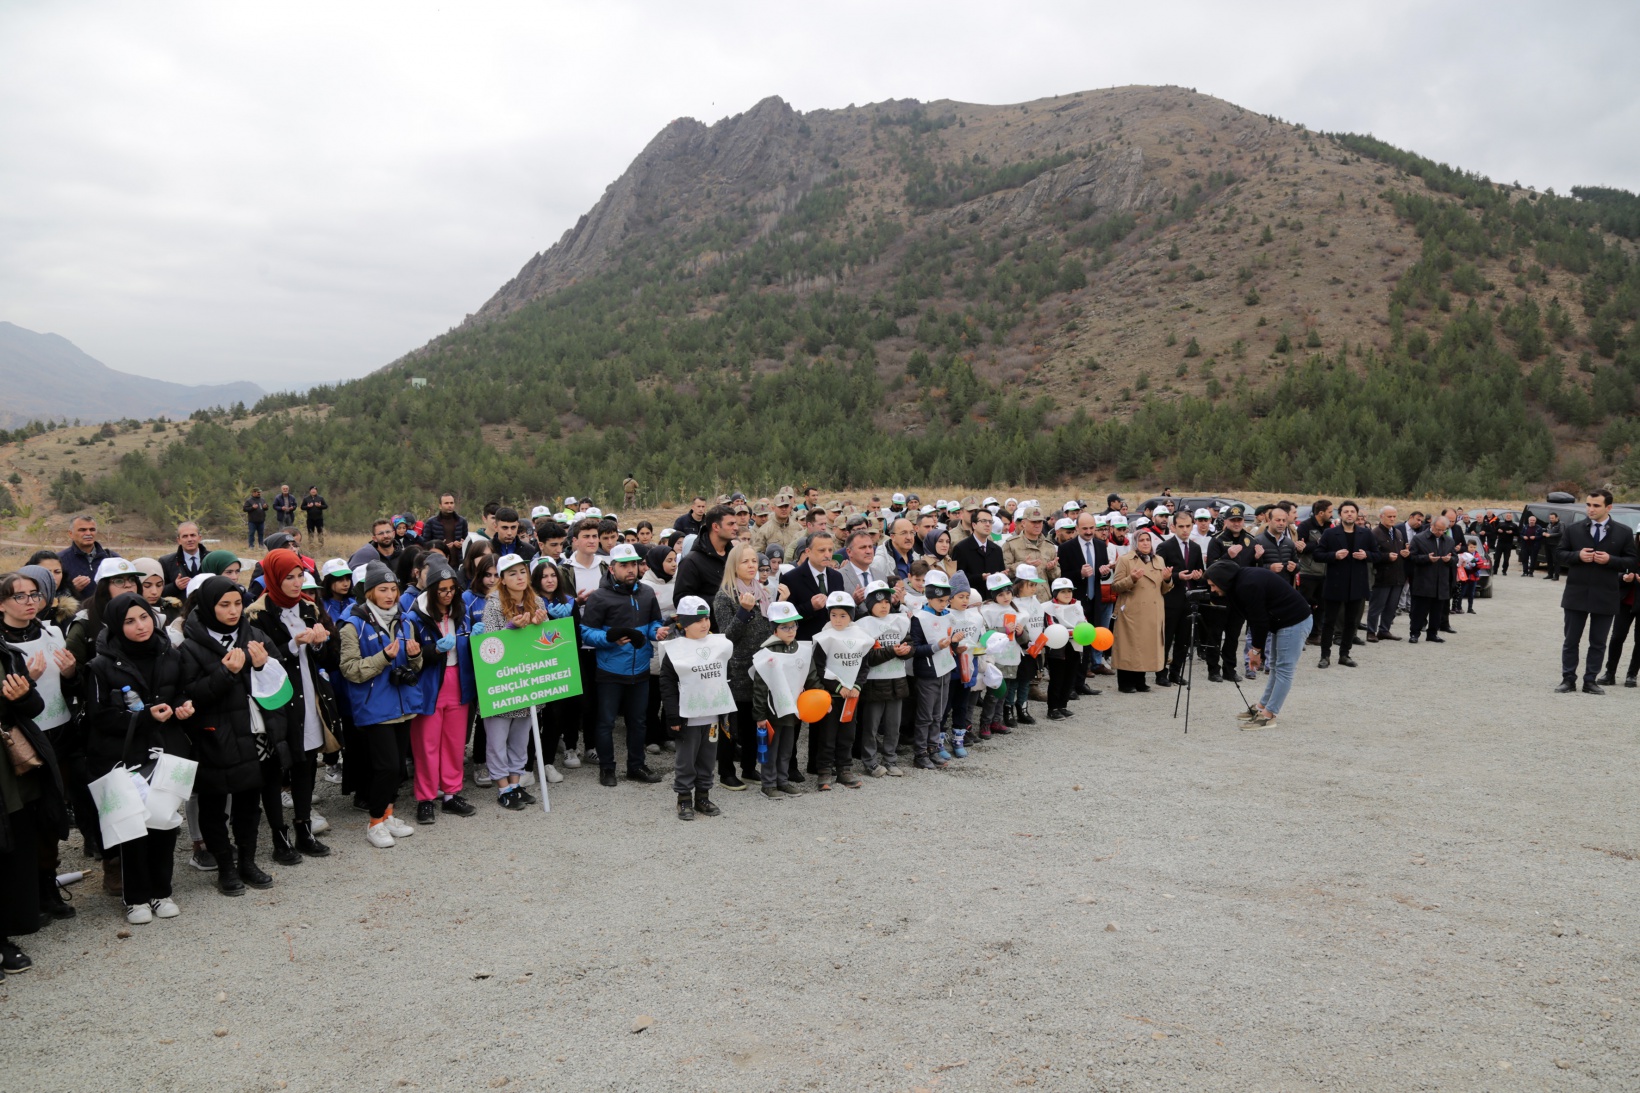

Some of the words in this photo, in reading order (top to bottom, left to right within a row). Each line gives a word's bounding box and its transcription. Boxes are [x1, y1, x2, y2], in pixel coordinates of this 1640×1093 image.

[496, 658, 558, 678] GÜMÜŞHANE
[700, 670, 722, 680] NEFES
[487, 678, 530, 695] GENÇLİK
[531, 667, 572, 685] MERKEZİ
[492, 694, 530, 710] HATIRA
[530, 684, 569, 700] ORMANI
